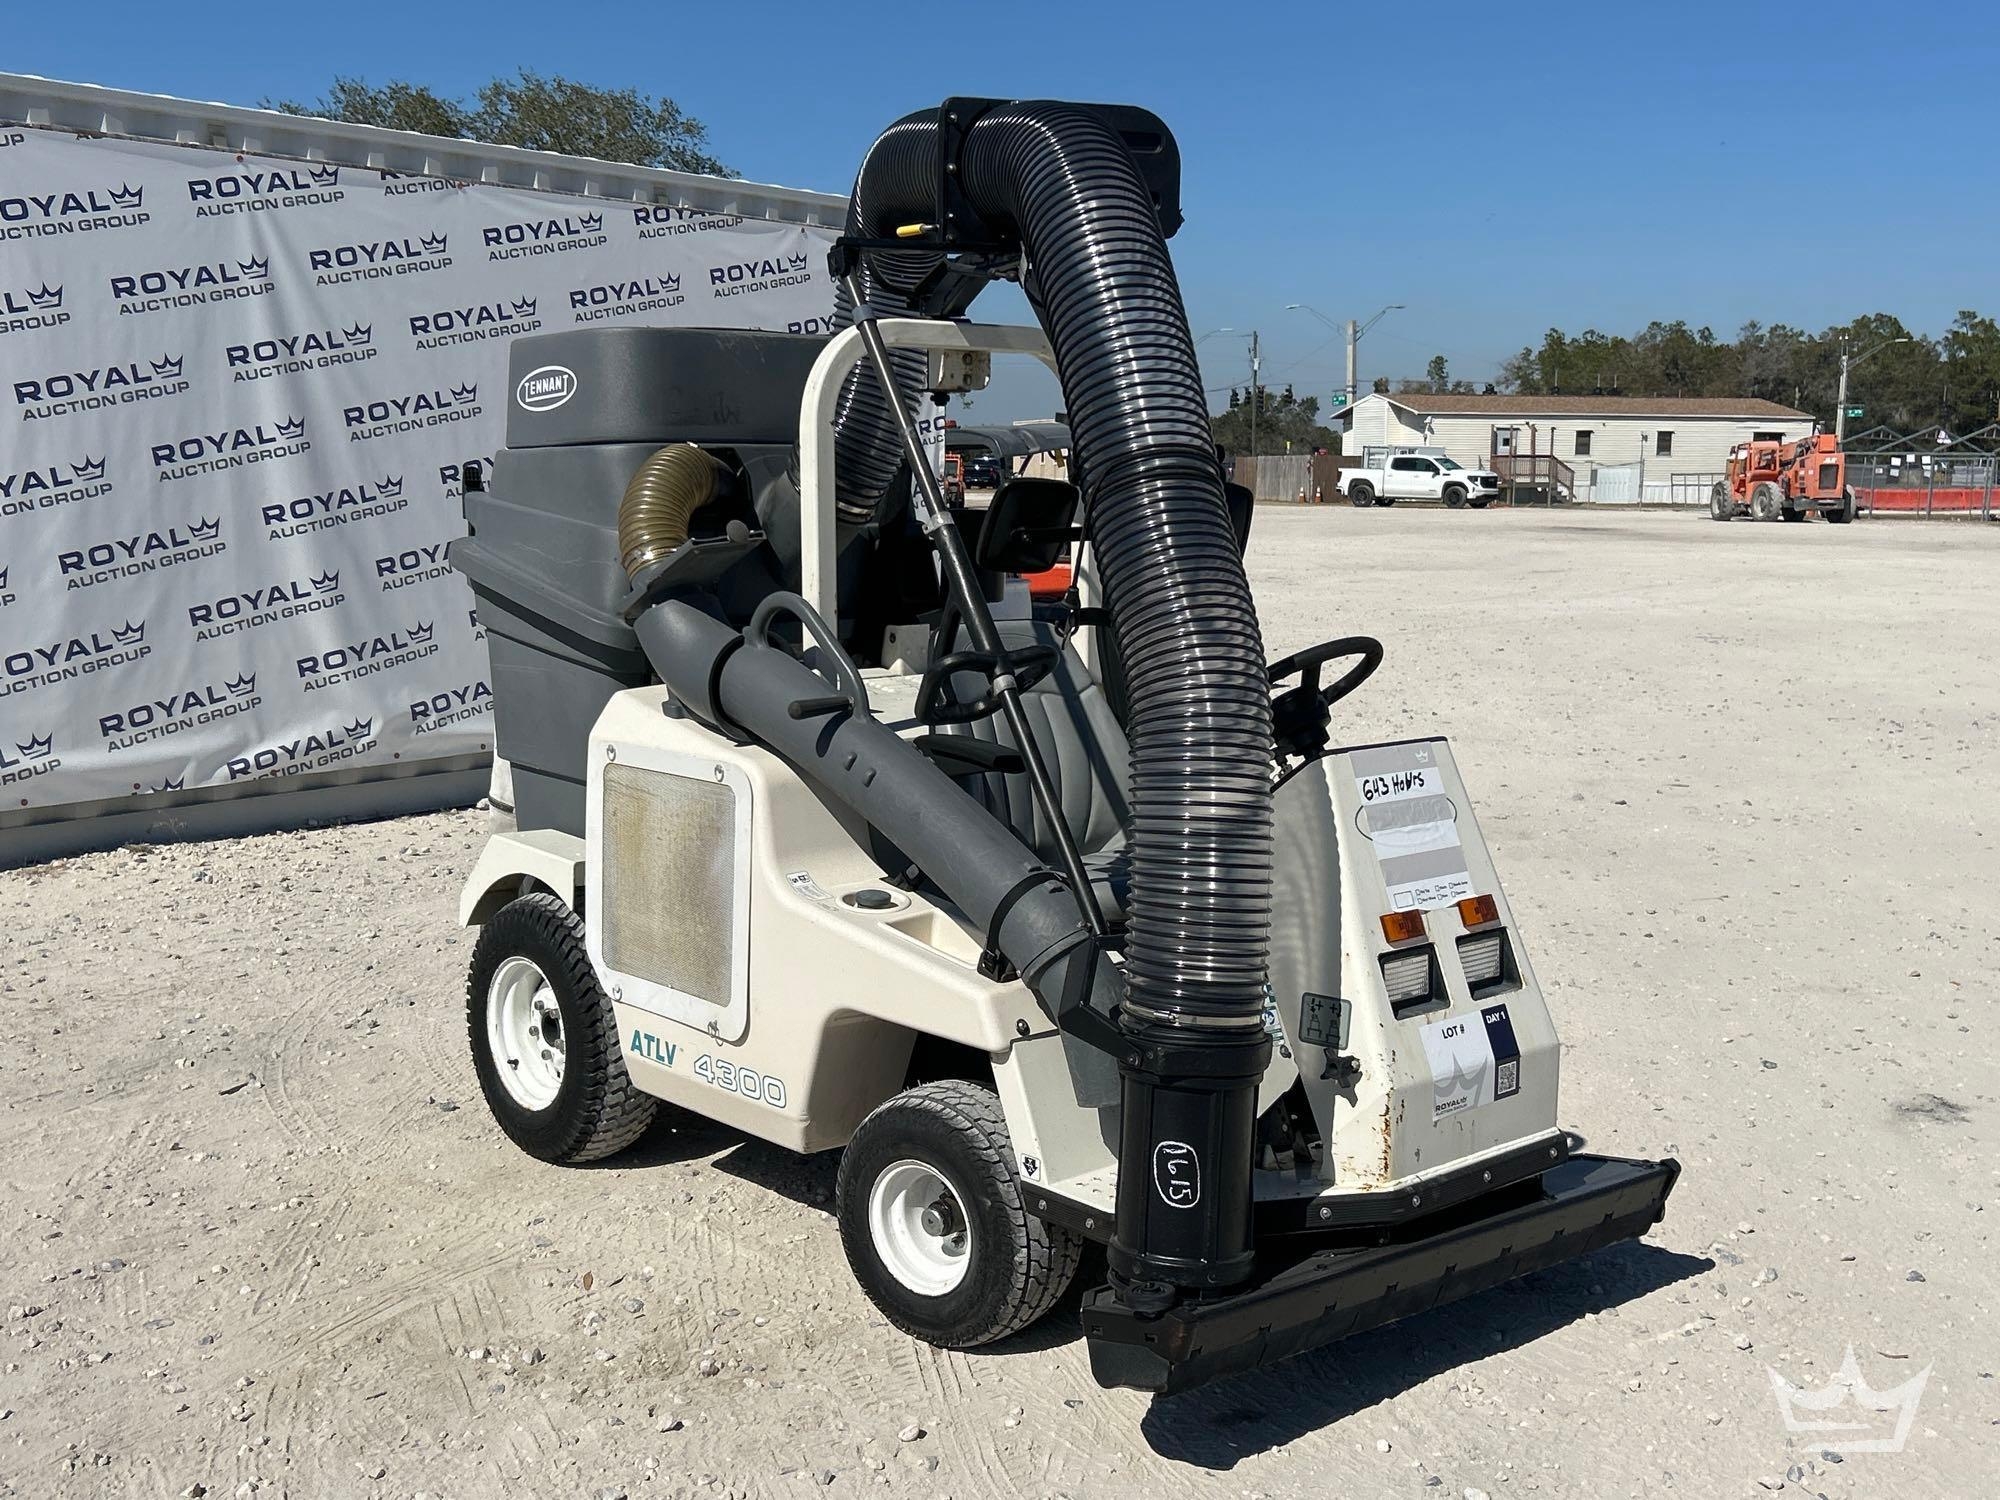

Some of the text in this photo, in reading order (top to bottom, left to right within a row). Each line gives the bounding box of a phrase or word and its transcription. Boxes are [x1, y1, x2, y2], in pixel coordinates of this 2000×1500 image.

[187, 170, 311, 201] ROYAL
[384, 179, 457, 197] AUCTION
[1, 191, 110, 221] OYAL
[196, 191, 345, 218] AUCTION GROUP
[78, 213, 150, 232] GROUP
[483, 218, 580, 247] ROYAL
[638, 217, 744, 240] AUCTION GROUP
[309, 239, 422, 271] ROYAL
[488, 235, 608, 262] AUCTION GROUP
[110, 263, 240, 299] ROYAL
[316, 257, 453, 287] AUCTION GROUP
[710, 258, 789, 286] ROYAL
[713, 273, 811, 298] AUCTION GROUP
[119, 282, 275, 315] AUCTION GROUP
[569, 279, 660, 309] ROYAL
[574, 295, 685, 323] AUCTION GROUP
[409, 303, 513, 335] ROYAL
[226, 330, 344, 367] ROYAL
[415, 320, 542, 351] AUCTION GROUP
[233, 348, 377, 383] AUCTION GROUP
[13, 363, 152, 404] ROYAL
[524, 374, 568, 402] TENNANT
[23, 381, 190, 421] AUCTION GROUP
[343, 391, 453, 427] ROYAL
[350, 406, 482, 442] AUCTION GROUP
[151, 426, 276, 467] ROYAL
[159, 441, 311, 482] AUCTION GROUP
[0, 467, 73, 498] YAL
[39, 482, 113, 508] GROUP
[261, 485, 377, 526] ROYAL
[269, 499, 409, 541] AUCTION GROUP
[58, 528, 190, 575] ROYAL
[67, 542, 226, 591] AUCTION GROUP
[375, 542, 451, 577] ROY
[382, 565, 453, 592] AUCTION
[188, 581, 312, 627] ROYAL
[196, 594, 346, 642] AUCTION GROUP
[0, 633, 113, 679] OYAL
[0, 645, 151, 697] UCTION GROUP
[296, 633, 409, 678] ROYAL
[303, 643, 439, 693] AUCTION GROUP
[99, 685, 227, 738] ROYAL
[410, 681, 493, 721] ROYA
[107, 696, 262, 753] AUCTION GROUP
[415, 704, 483, 736] AUCTION
[226, 730, 344, 780] ROYAL
[317, 740, 377, 767] GROUP
[0, 758, 61, 786] ROUP
[1362, 777, 1389, 801] 643
[1441, 1025, 1458, 1039] LOT
[1486, 1011, 1506, 1024] DAY 1
[630, 1029, 676, 1066] ATLV
[693, 1054, 787, 1109] 4300
[1435, 1098, 1460, 1112] ROYAL
